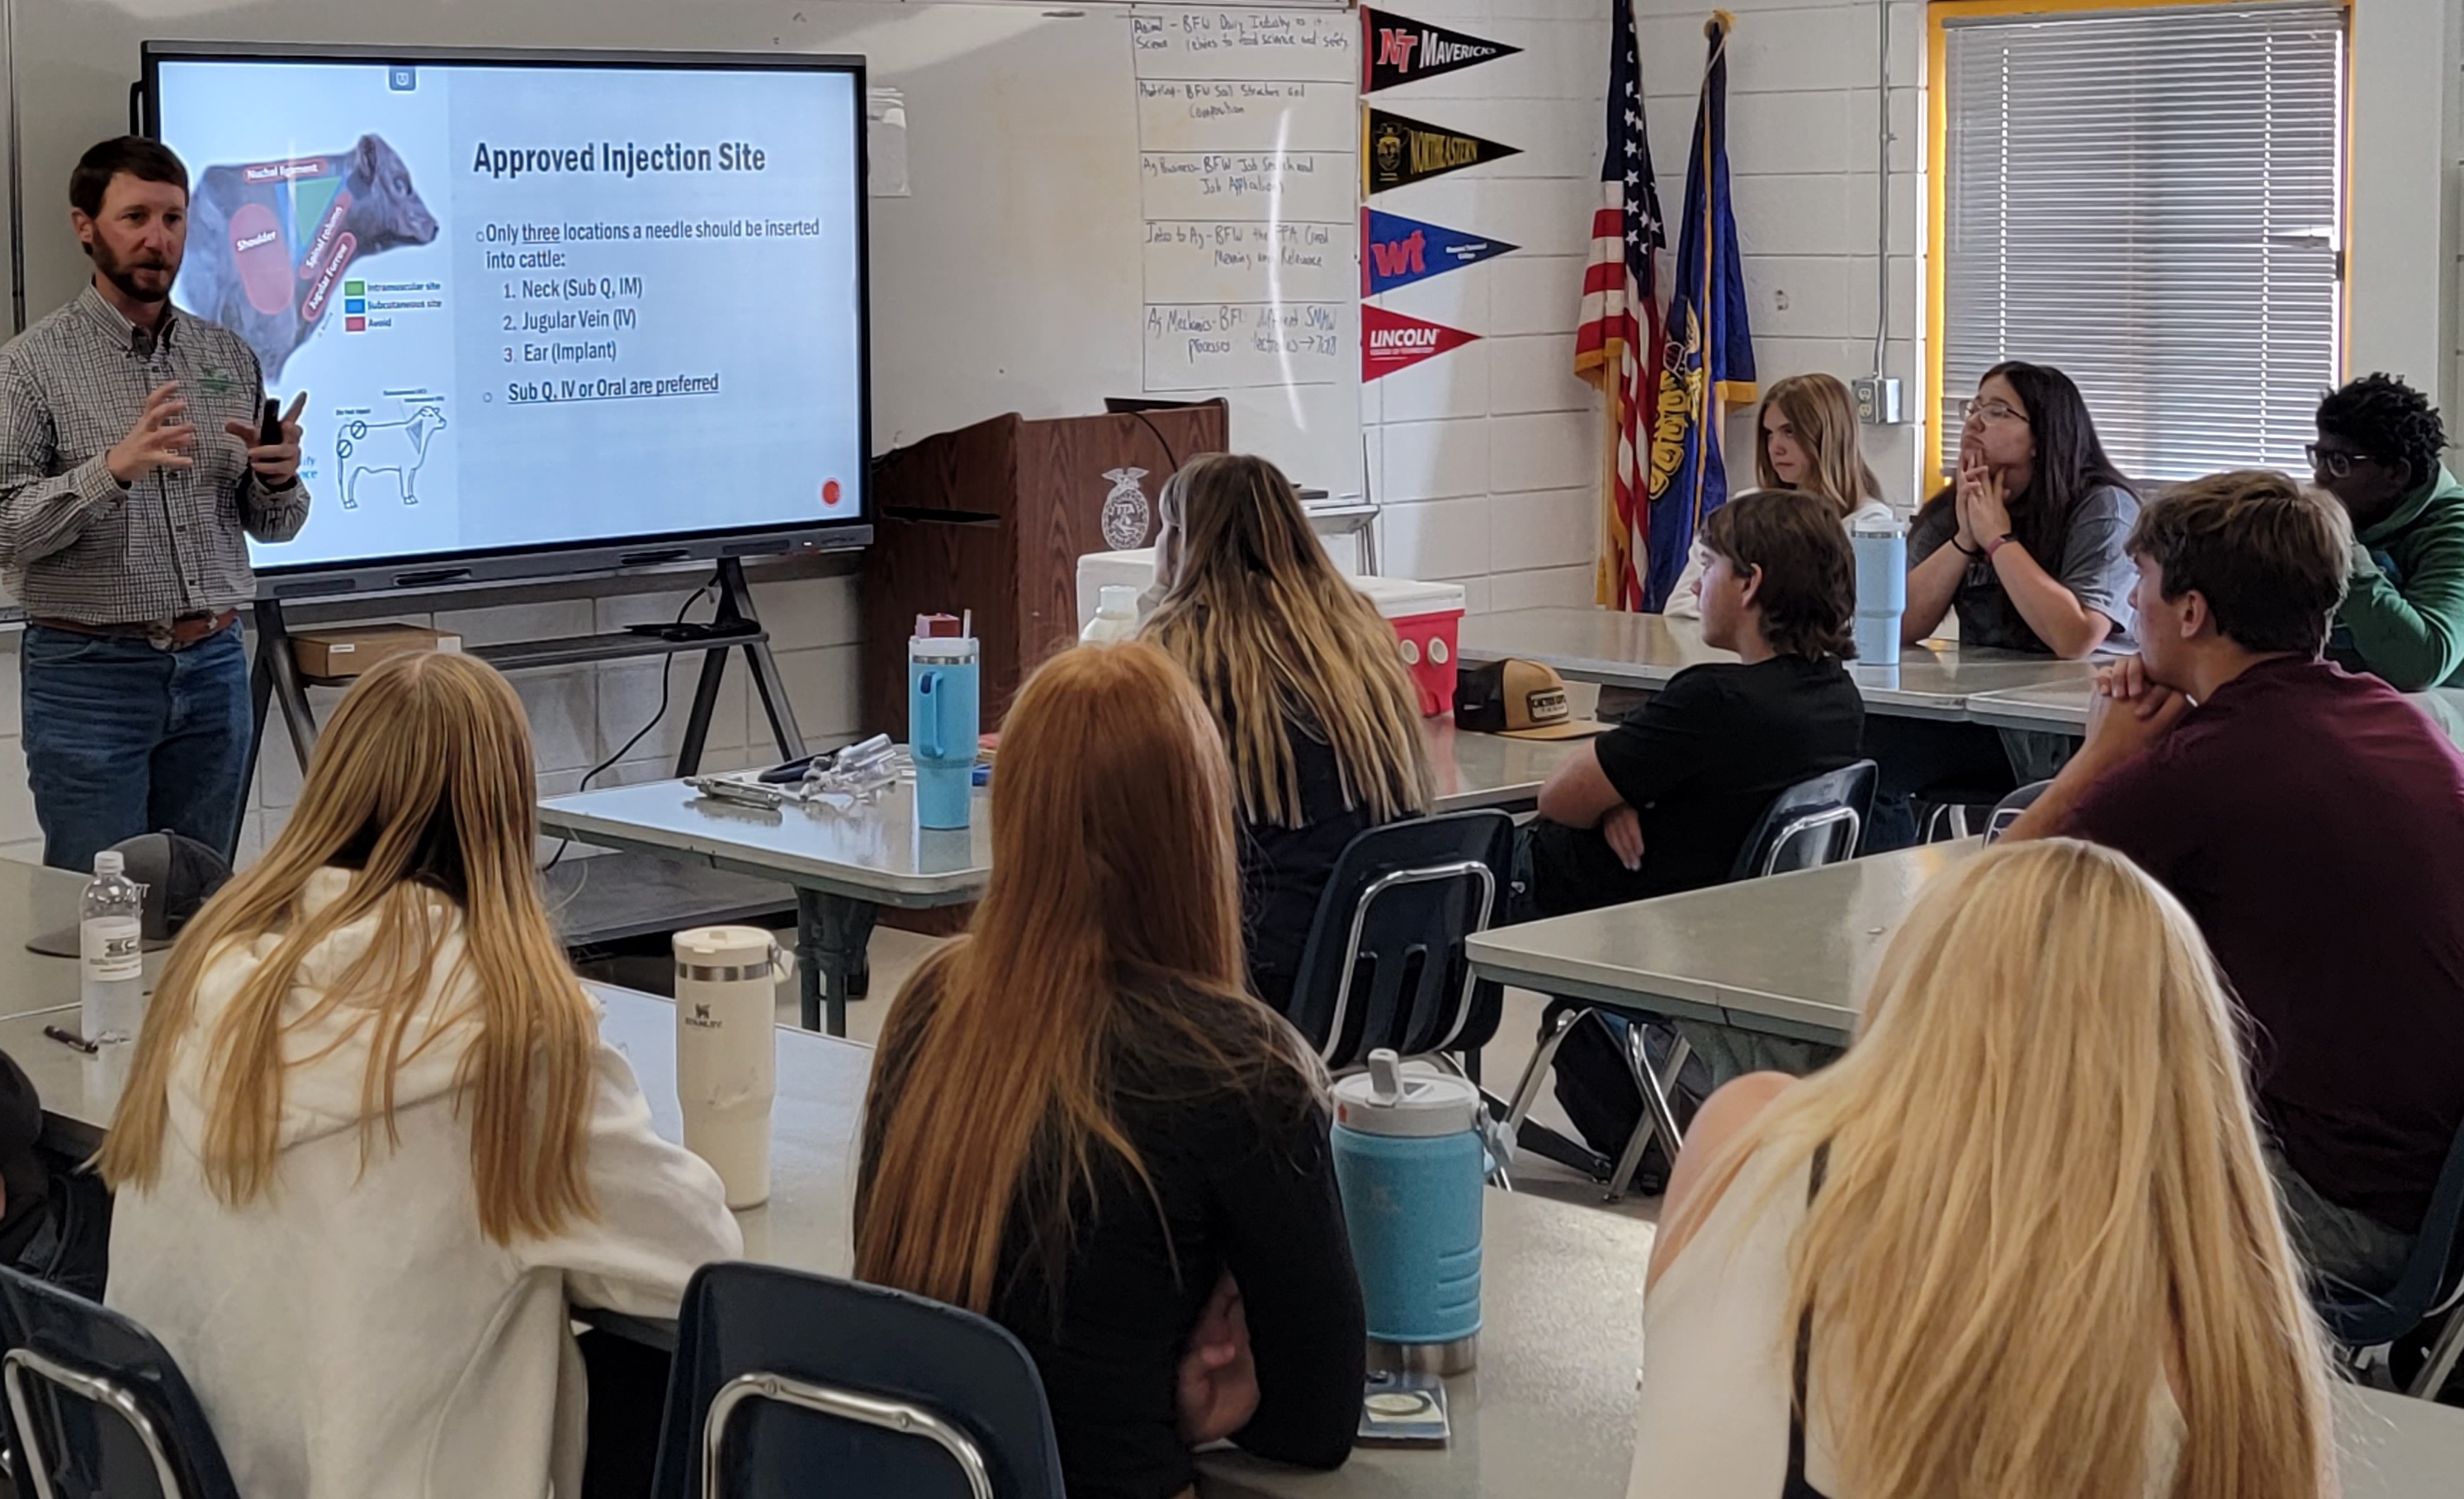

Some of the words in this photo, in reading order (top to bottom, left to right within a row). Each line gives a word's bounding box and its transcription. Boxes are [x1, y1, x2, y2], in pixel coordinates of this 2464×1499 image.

[1376, 28, 1418, 73] NT
[1418, 29, 1497, 69] MAVERICKS
[473, 142, 595, 178] Approved
[603, 142, 712, 178] Injection
[718, 141, 766, 172] Site
[1203, 155, 1232, 174] BFW
[1237, 157, 1257, 173] Job
[1199, 177, 1222, 195] Job
[236, 230, 277, 252] Shoulder
[485, 223, 518, 245] Only
[522, 222, 560, 243] three
[563, 221, 630, 241] locations
[632, 225, 642, 239] a
[646, 220, 693, 239] needle
[696, 220, 741, 238] should
[745, 220, 763, 237] be
[764, 218, 819, 237] inserted
[1189, 225, 1205, 250] Ag
[1214, 225, 1243, 246] BFW
[486, 249, 515, 270] into
[518, 249, 566, 269] cattle:
[425, 281, 442, 291] site
[504, 283, 517, 300] 1.
[522, 279, 560, 300] Neck
[562, 279, 598, 302] (Sub
[618, 277, 643, 299] IM)
[368, 318, 392, 328] Avoid
[504, 314, 518, 332] 2.
[521, 311, 577, 333] Jugular
[578, 310, 610, 329] Vein
[612, 308, 636, 331] (IV)
[1147, 306, 1163, 340] Ag
[1369, 328, 1438, 348] LINCOLN
[504, 347, 518, 364] 3.
[523, 343, 549, 362] Ear
[551, 340, 617, 364] (Implant)
[508, 383, 538, 402] Sub
[561, 381, 576, 400] IV
[579, 385, 594, 400] or
[597, 377, 627, 397] Oral
[630, 380, 654, 396] are
[655, 373, 720, 400] preferred
